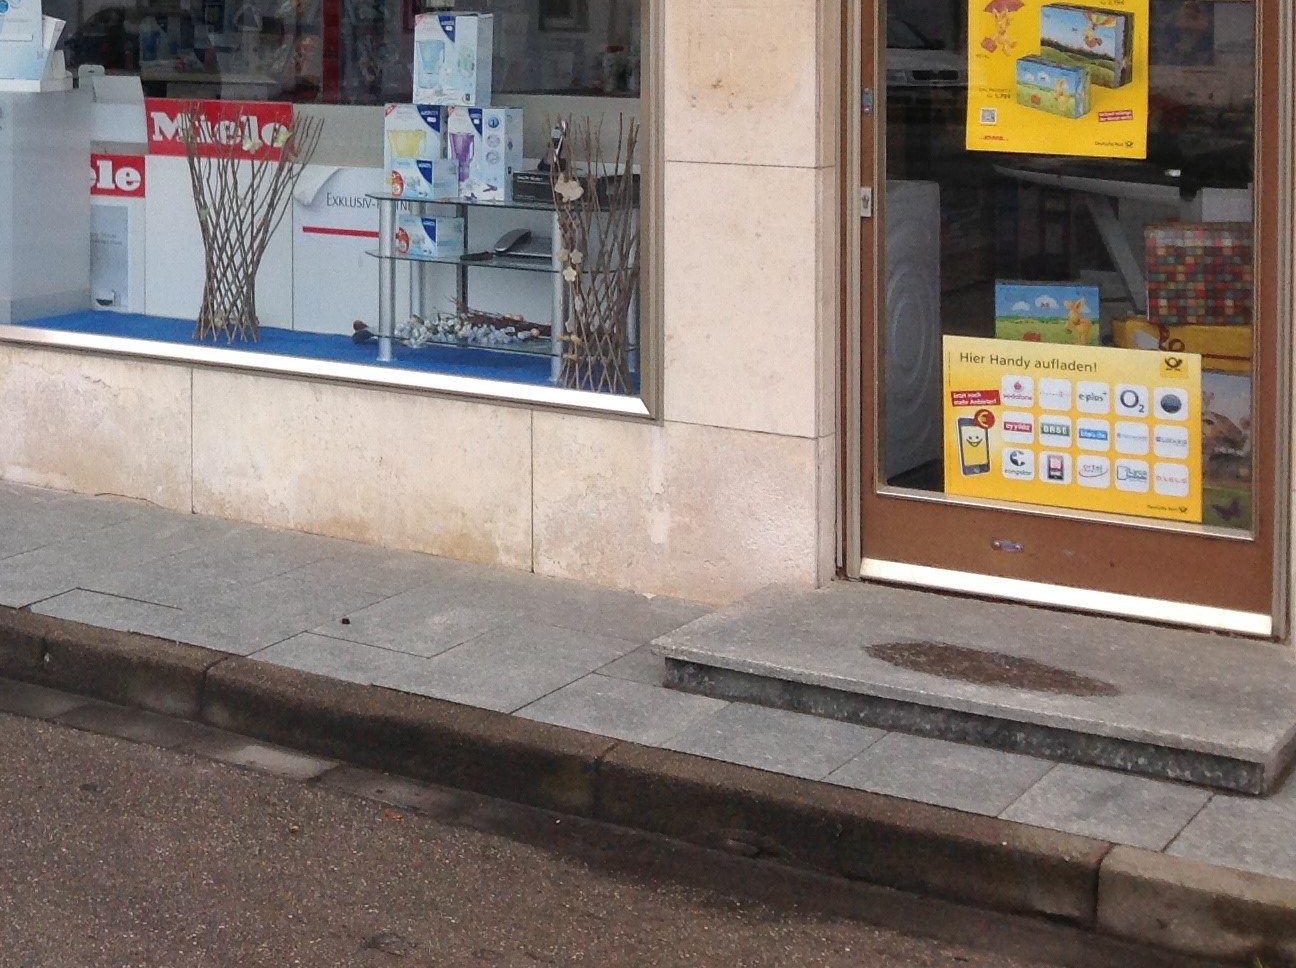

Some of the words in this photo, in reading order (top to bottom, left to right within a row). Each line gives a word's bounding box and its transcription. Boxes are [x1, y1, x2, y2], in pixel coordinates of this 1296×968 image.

[150, 110, 289, 148] Miele
[960, 352, 985, 364] Hier
[990, 354, 1030, 370] Handy
[1034, 357, 1098, 373] aufladen!
